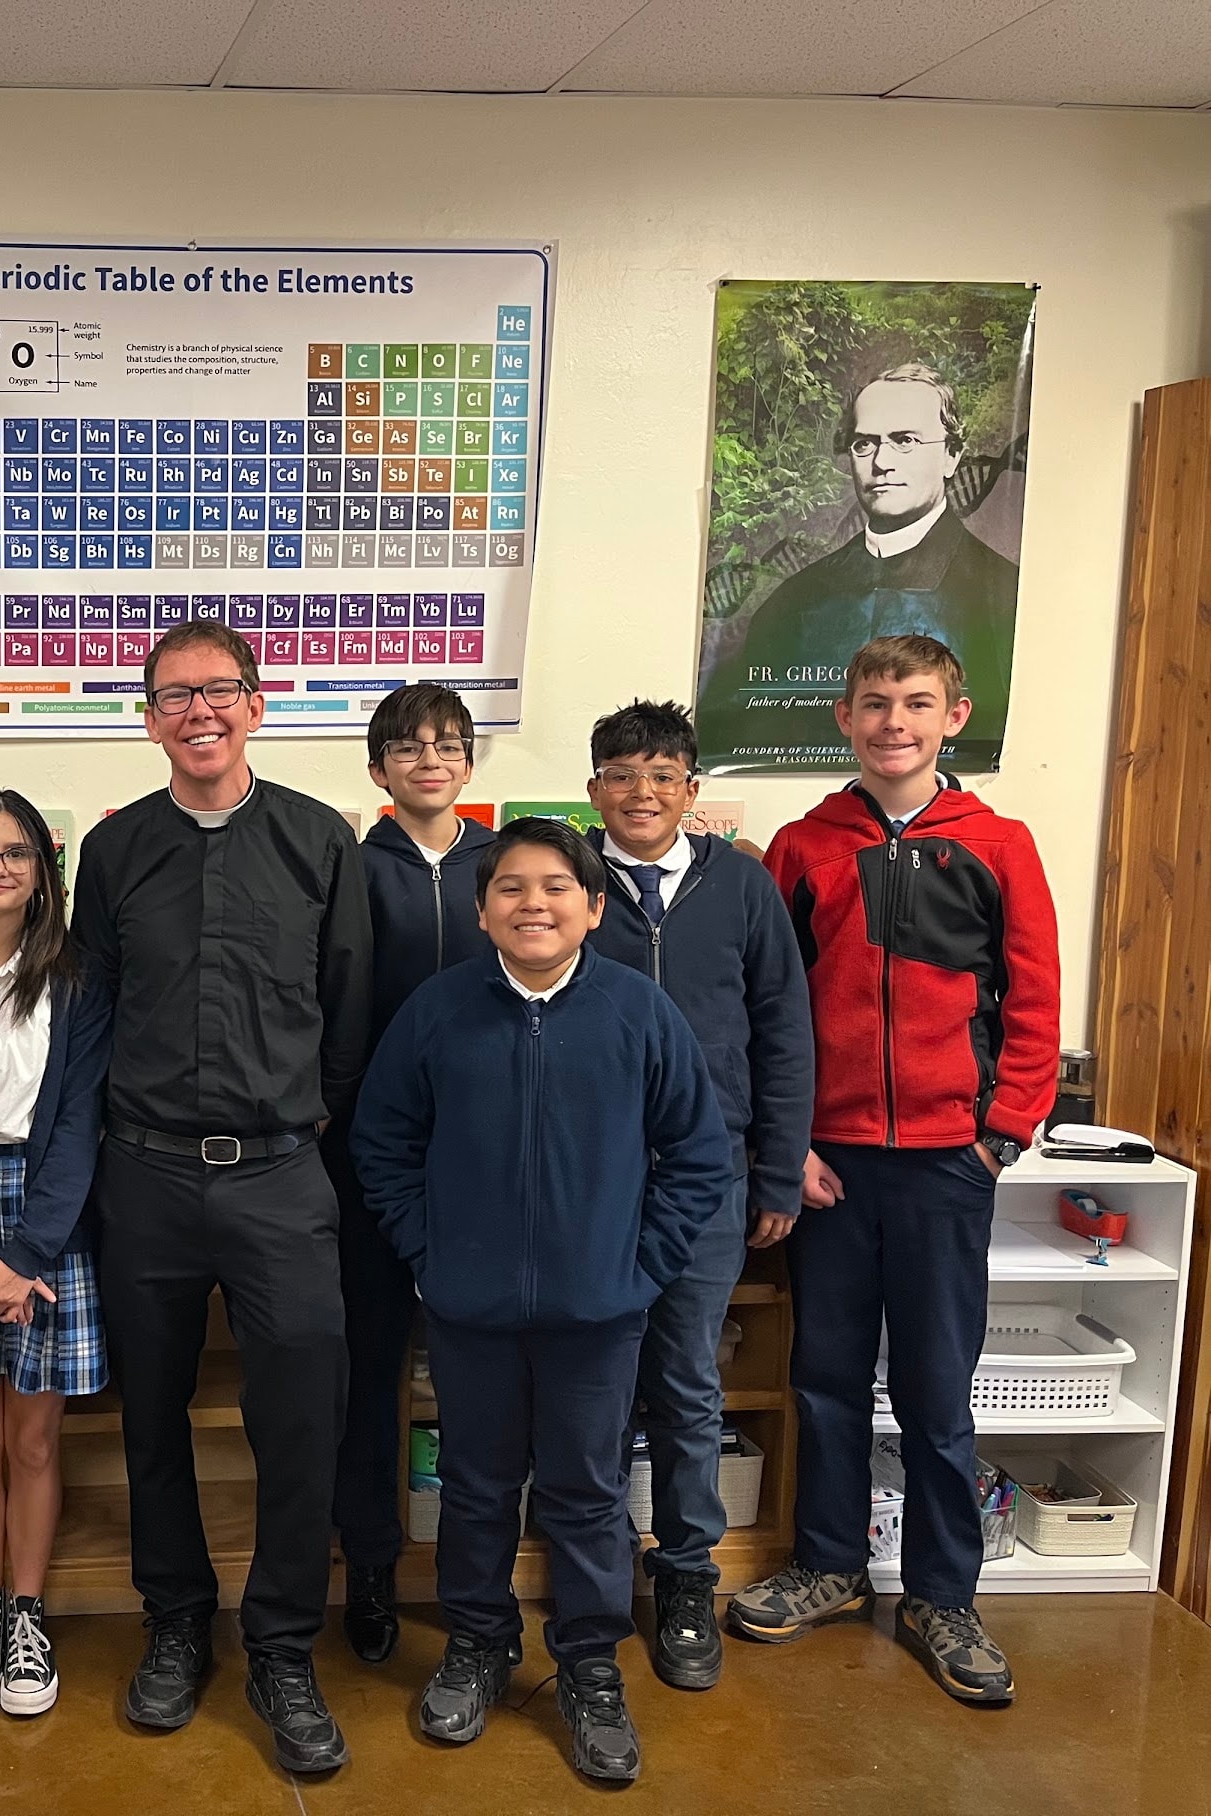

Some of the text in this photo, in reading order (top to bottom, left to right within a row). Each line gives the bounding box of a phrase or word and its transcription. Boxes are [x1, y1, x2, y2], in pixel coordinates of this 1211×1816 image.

[95, 266, 175, 292] Table
[184, 266, 214, 293] of
[220, 267, 269, 293] the
[278, 268, 414, 294] Elements
[73, 322, 101, 331] Atomic
[503, 315, 525, 331] He
[73, 331, 101, 340] weight
[11, 342, 35, 369] O
[74, 352, 104, 360] Symbol
[126, 344, 165, 353] Chemistry
[168, 344, 174, 352] is
[182, 345, 206, 353] branch
[208, 345, 218, 353] of
[220, 345, 250, 354] physical
[253, 345, 283, 353] science
[126, 355, 278, 366] that studies the composition, structure,
[320, 354, 331, 369] B
[357, 354, 368, 369] C
[395, 354, 406, 369] N
[433, 354, 445, 369] O
[471, 354, 480, 369] F
[502, 354, 523, 369] Ne
[126, 367, 166, 375] properties
[168, 367, 183, 375] and
[185, 367, 212, 376] change
[215, 367, 223, 375] of
[8, 377, 38, 386] Oxygen
[74, 380, 98, 388] Name
[309, 384, 319, 392] 13
[316, 392, 333, 407] Al
[355, 392, 370, 407] Si
[396, 392, 406, 407] P
[433, 392, 442, 407] S
[466, 392, 482, 407] Cl
[501, 392, 519, 407] Ar
[271, 422, 280, 430] 30
[86, 428, 109, 444] Mn
[126, 428, 145, 444] Fe
[163, 428, 184, 444] Co
[239, 429, 259, 445] Cu
[277, 429, 297, 445] Zn
[390, 429, 409, 443] As
[464, 429, 481, 443] Br
[501, 429, 519, 445] Kr
[43, 459, 53, 467] 42
[238, 468, 260, 485] Ag
[352, 468, 371, 485] Sn
[498, 468, 518, 485] Xe
[271, 498, 280, 506] 80
[51, 505, 67, 520] W
[275, 506, 297, 524] Hg
[351, 506, 370, 520] Pb
[498, 506, 518, 520] Rn
[270, 536, 283, 544] 112
[492, 535, 505, 543] 118
[49, 544, 69, 562] Sg
[274, 543, 295, 558] Cn
[496, 543, 518, 561] Og
[48, 605, 70, 619] Nd
[84, 605, 109, 619] Pm
[273, 603, 294, 621] Dy
[54, 643, 64, 657] U
[380, 640, 404, 655] Md
[748, 666, 779, 682] FR.
[13, 684, 33, 692] earth
[35, 684, 55, 692] metal
[328, 681, 385, 690] Transition metal
[485, 680, 505, 689] metal
[34, 704, 110, 713] Polyatomic nonmetal
[280, 701, 315, 711] Noble gas
[746, 696, 833, 709] father of modern
[732, 747, 785, 755] FOUNDERS
[788, 747, 802, 755] OF
[804, 746, 848, 755] SCIENCE
